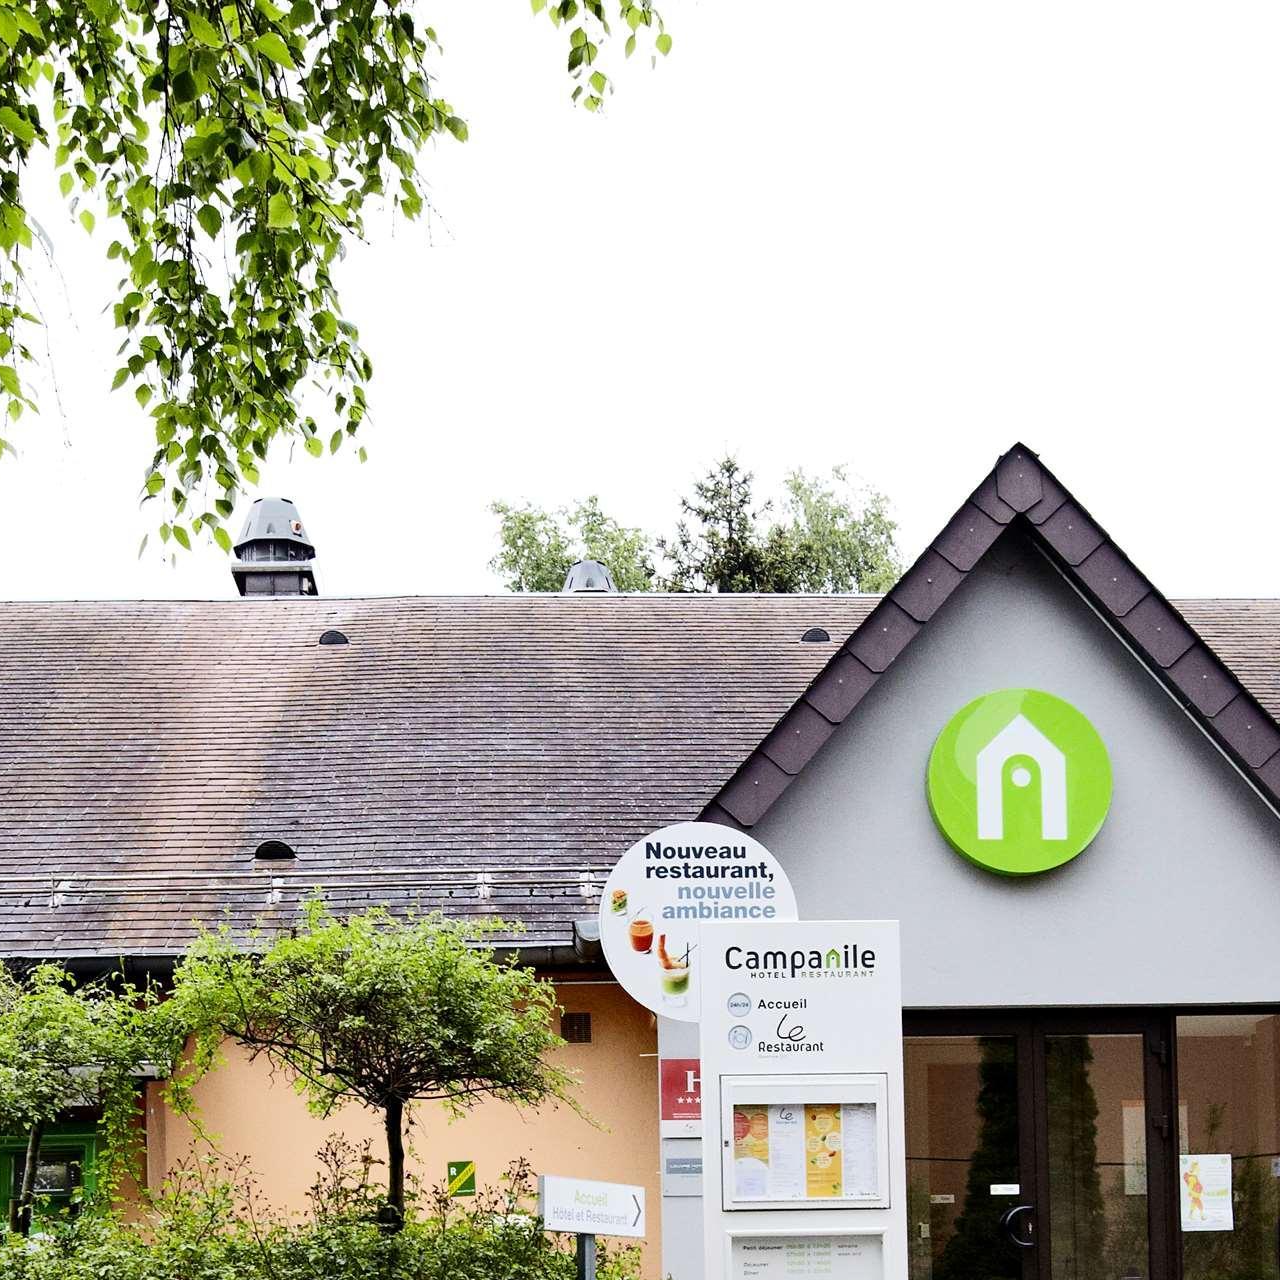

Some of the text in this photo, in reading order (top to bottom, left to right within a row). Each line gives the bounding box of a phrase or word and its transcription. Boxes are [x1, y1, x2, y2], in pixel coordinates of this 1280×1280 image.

[645, 841, 746, 860] Nouveau
[645, 861, 774, 882] restaurant,
[677, 881, 776, 900] nouvelle
[662, 902, 776, 919] ambiance
[725, 944, 876, 978] Campanile
[750, 970, 875, 979] HOTEL RESTAURANT
[757, 998, 807, 1009] Accueil
[776, 1013, 807, 1042] Le
[758, 1041, 824, 1052] Restaurant
[450, 1167, 457, 1176] R
[575, 1189, 608, 1206] Accueil
[575, 1209, 584, 1222] et
[586, 1209, 627, 1224] Restaurant
